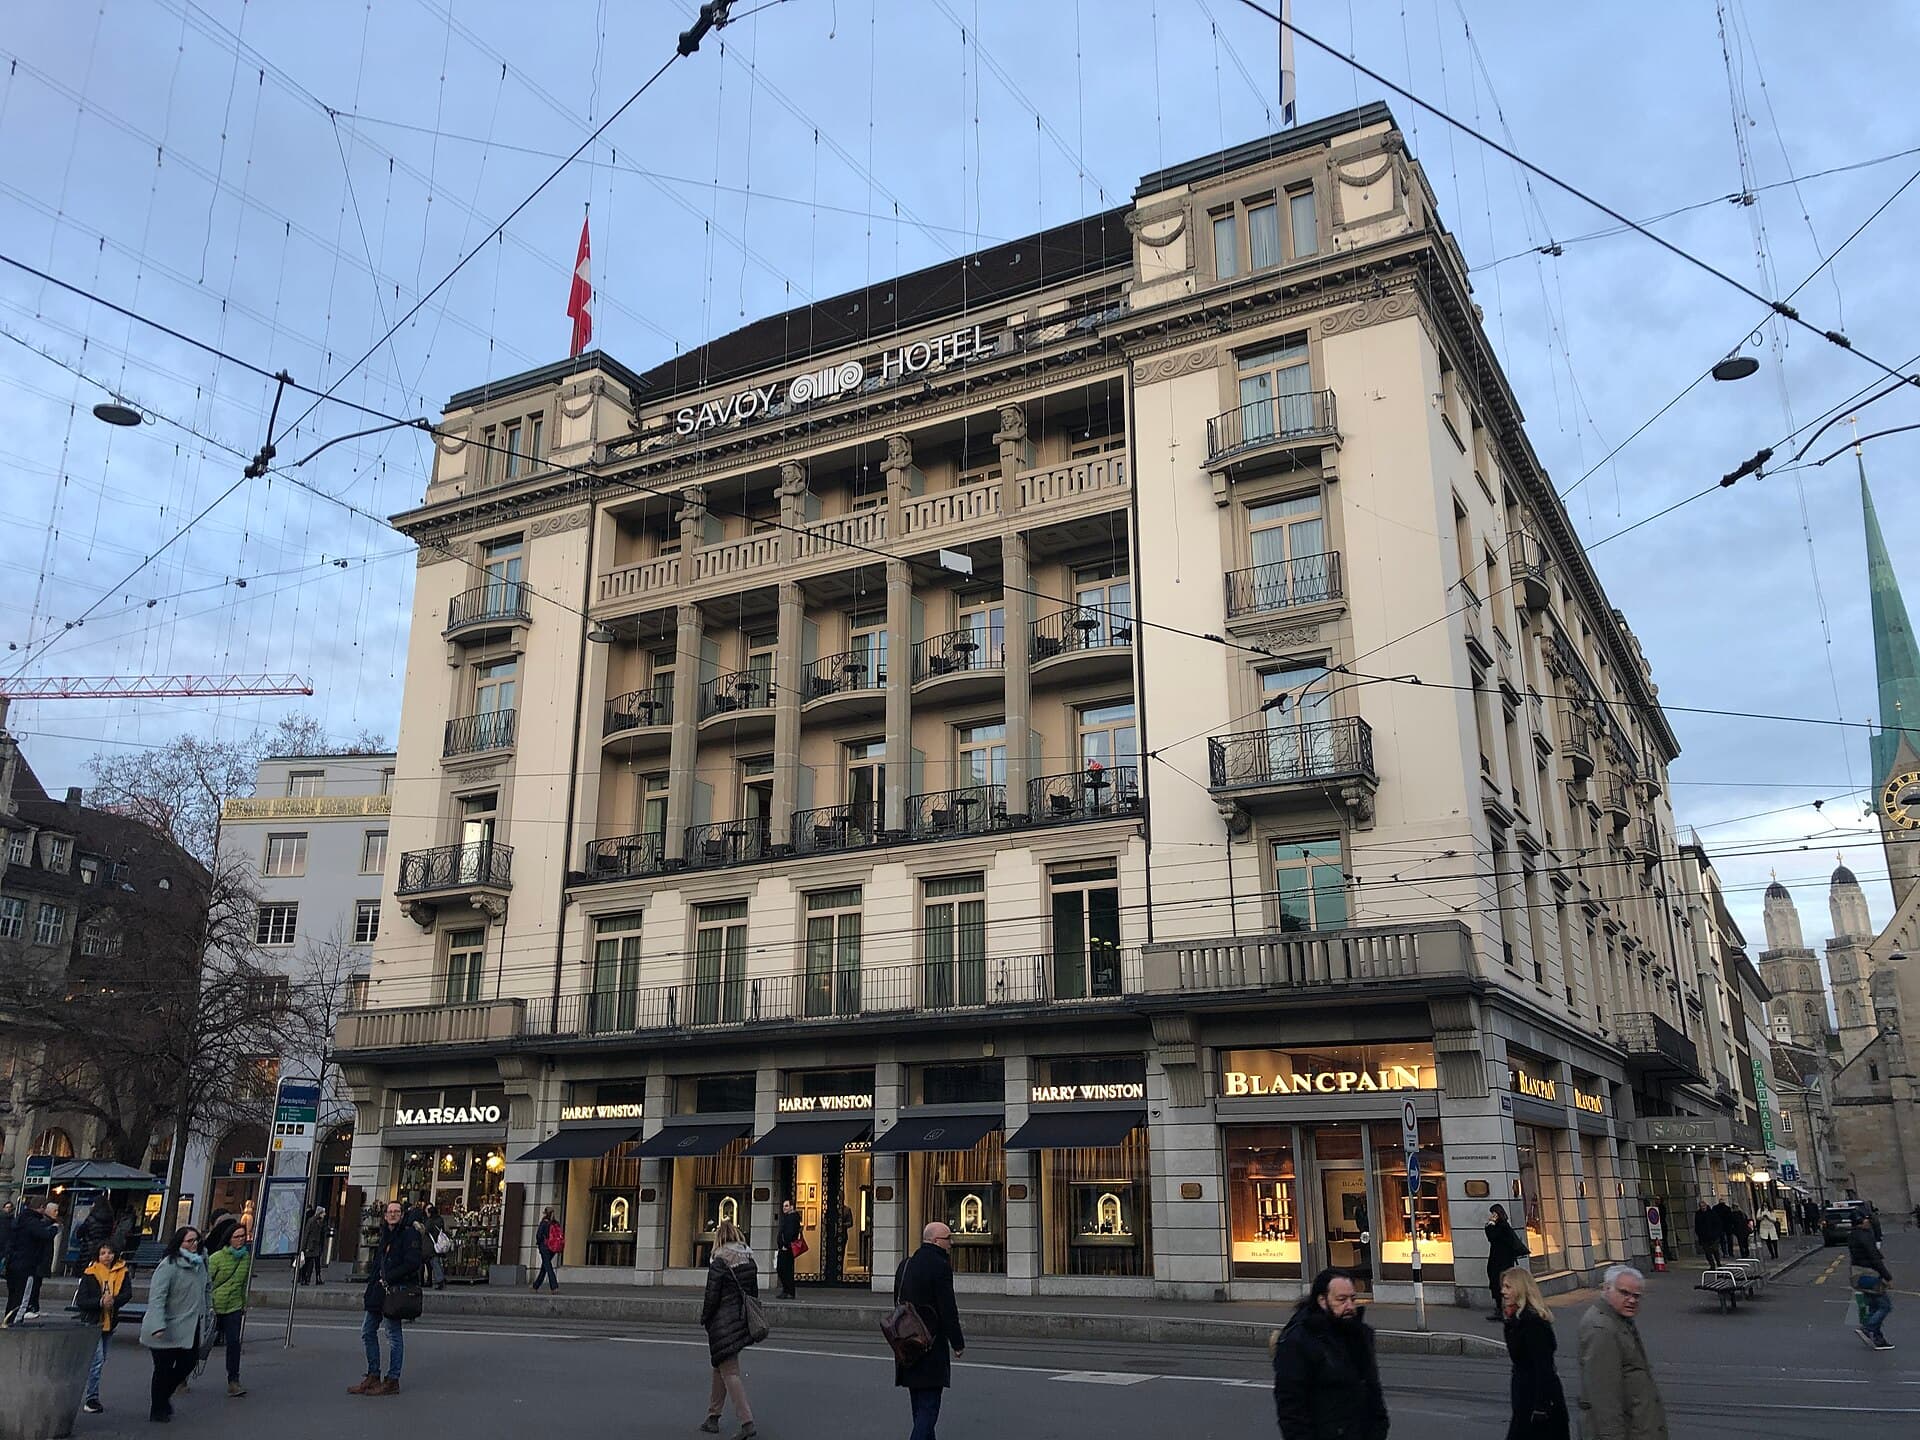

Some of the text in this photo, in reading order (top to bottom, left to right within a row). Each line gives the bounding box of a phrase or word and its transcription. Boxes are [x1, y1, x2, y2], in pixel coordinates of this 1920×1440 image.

[676, 325, 993, 435] SAVOY HOTEL
[1032, 1083, 1144, 1102] HARRY WINSTON
[1225, 1065, 1421, 1096] BLANCPAIN
[1518, 1070, 1556, 1101] BLANCPAIN
[561, 1103, 643, 1120] HARRY WINSTON
[778, 1094, 873, 1112] HARRY WINSTON
[1574, 1088, 1603, 1114] BLANCPAIN
[1753, 1060, 1776, 1150] PHARMACIE
[395, 1105, 501, 1125] MARSANO
